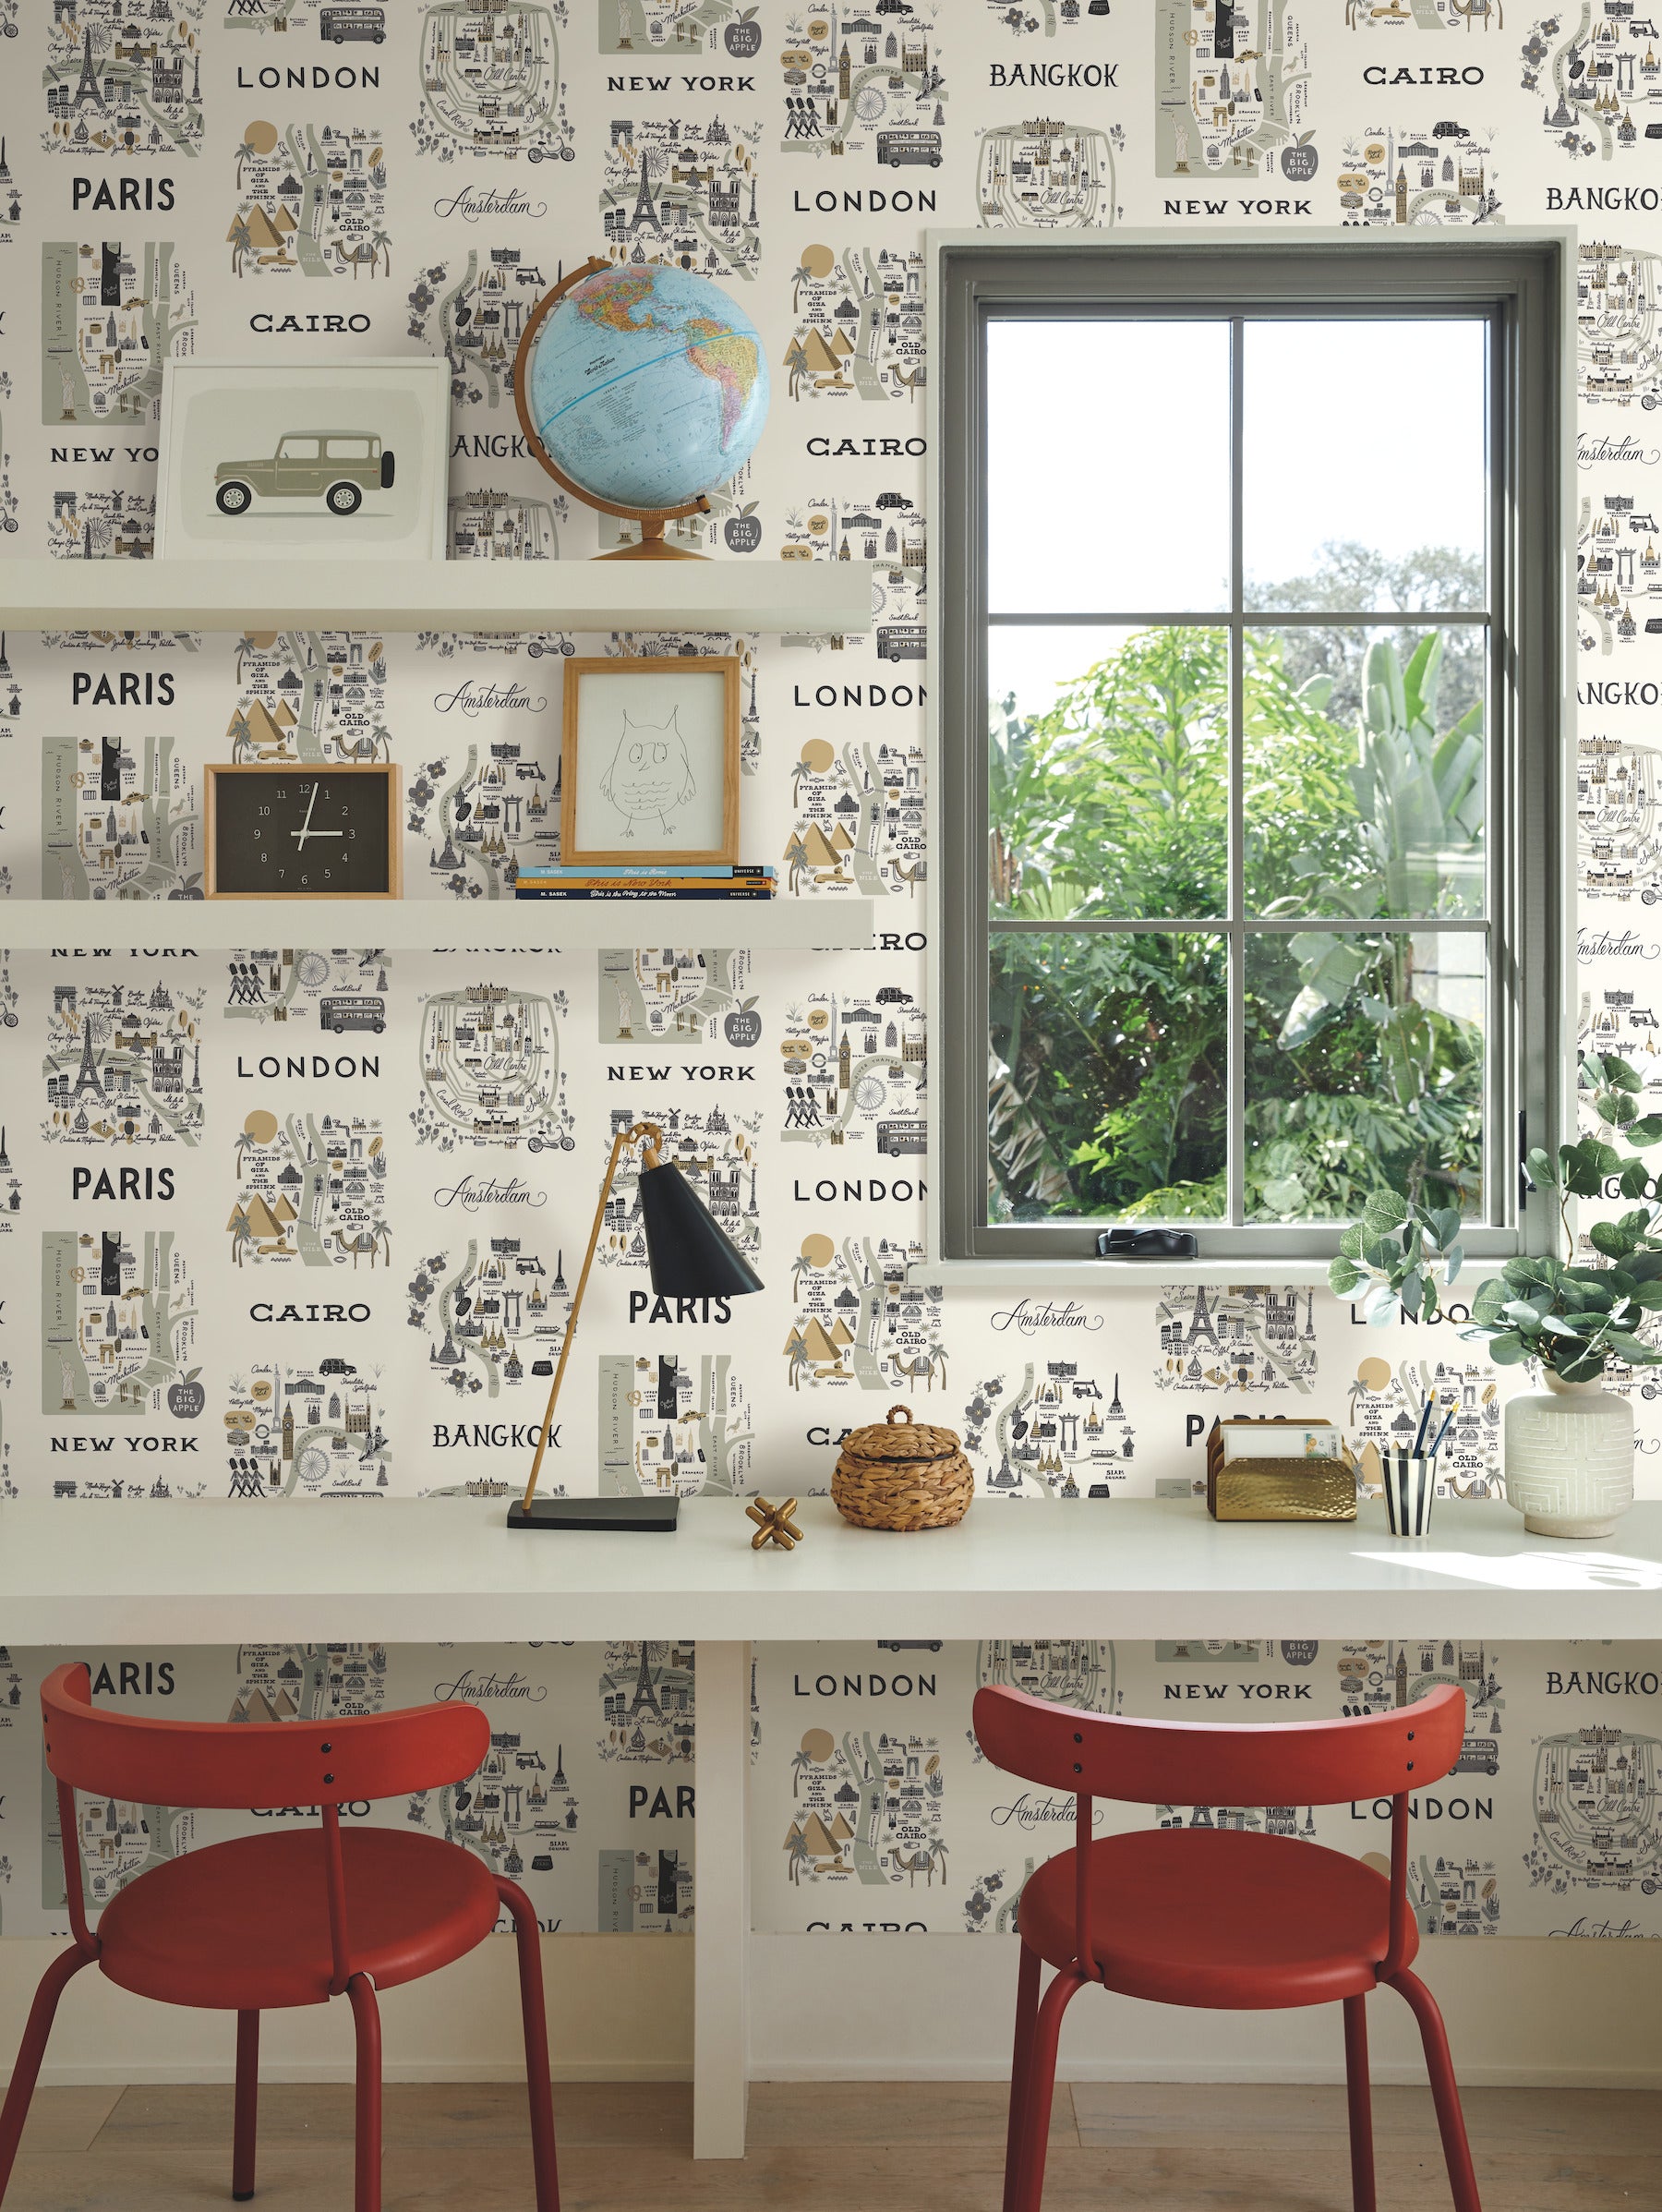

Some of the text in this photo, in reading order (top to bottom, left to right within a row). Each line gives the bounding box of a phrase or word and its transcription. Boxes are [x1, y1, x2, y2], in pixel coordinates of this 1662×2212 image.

[729, 43, 756, 52] APPLE
[237, 66, 379, 89] LONDON
[608, 75, 756, 91] NEW YORK
[854, 74, 868, 90] RIVER
[990, 63, 1119, 87] BANGKOK
[1363, 66, 1485, 86] CAIRO
[1286, 167, 1313, 175] APPLE
[73, 176, 175, 211] PARIS
[794, 189, 936, 212] LONDON
[1546, 187, 1662, 211] BANGKO
[434, 185, 548, 222] Amsterdam
[1164, 199, 1313, 215] NEW YORK
[249, 314, 371, 333] CAIRO
[1596, 313, 1641, 328] Old Centre
[51, 446, 159, 463] NEW YO
[450, 435, 553, 458] ANGKO
[806, 437, 928, 456] CAIRO
[729, 538, 756, 546] APPLE
[73, 671, 175, 705] PARIS
[1577, 682, 1662, 706] NGKO
[434, 679, 548, 716] Amsterdam
[276, 791, 287, 799] 11
[299, 784, 310, 793] 12
[324, 791, 331, 800] 1
[259, 806, 271, 816] 10
[342, 806, 349, 816] 2
[254, 829, 261, 840] 9
[348, 829, 355, 840] 3
[260, 852, 268, 863] 8
[342, 852, 349, 863] 4
[278, 869, 285, 878] 7
[301, 876, 308, 885] 6
[324, 869, 331, 878] 5
[584, 878, 609, 887] This
[622, 878, 647, 887] New
[648, 878, 672, 888] York
[590, 889, 605, 898] This
[657, 889, 677, 898] Moon
[729, 1033, 756, 1041] APPLE
[237, 1056, 379, 1078] LONDON
[483, 1056, 527, 1070] Old Centre
[608, 1064, 756, 1081] NEW YORK
[73, 1166, 175, 1200] PARIS
[434, 1174, 548, 1211] Amsterdam
[249, 1303, 371, 1323] CAIRO
[630, 1290, 732, 1324] PARIS
[1351, 1303, 1470, 1325] LNDO
[991, 1298, 1104, 1335] Amsterdam
[173, 1404, 199, 1412] APPLE
[51, 1435, 199, 1452] NEW YORK
[432, 1424, 562, 1448] BANGKOK
[1286, 1651, 1313, 1660] APPLE
[82, 1662, 175, 1695] ARIS
[794, 1674, 936, 1697] LONDON
[1546, 1671, 1662, 1695] BANGKO
[434, 1669, 548, 1706] Amsterdam
[1164, 1683, 1313, 1699] NEW YORK
[630, 1785, 695, 1819] PAR
[991, 1793, 1104, 1831] Amsterda
